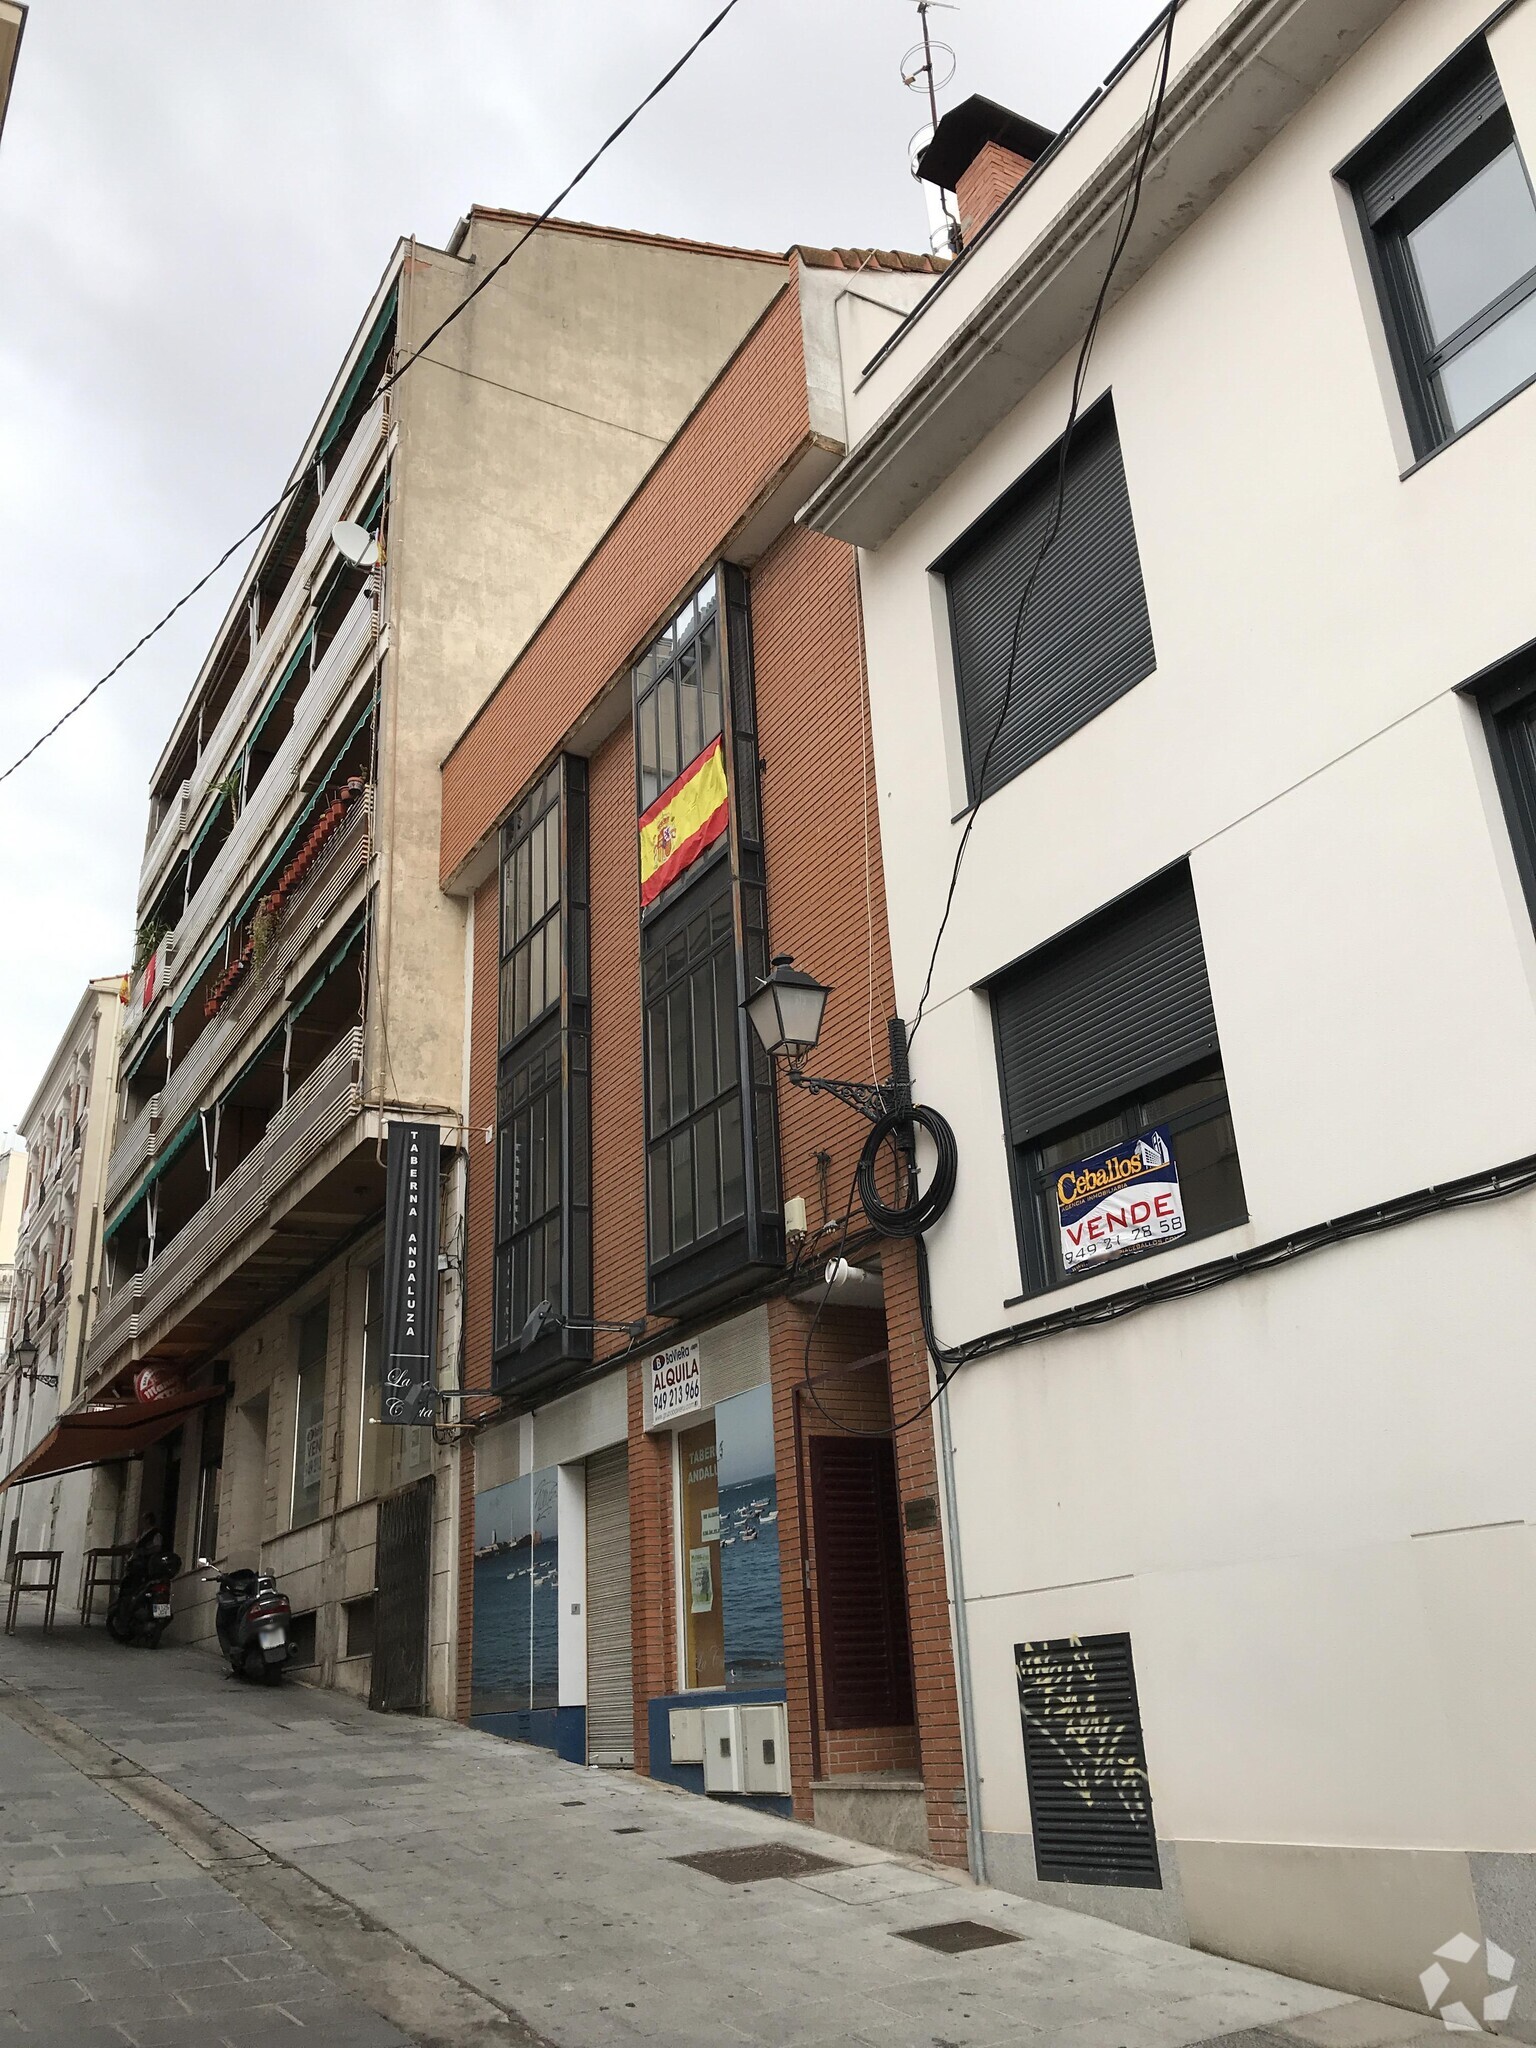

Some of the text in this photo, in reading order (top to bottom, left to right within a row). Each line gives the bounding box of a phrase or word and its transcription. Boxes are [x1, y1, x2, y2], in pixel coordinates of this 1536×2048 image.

[1057, 1153, 1142, 1205] Ceballos
[406, 1131, 419, 1337] TABERNA ANDALUZA
[1065, 1216, 1183, 1265] 949 21 78 58
[1066, 1193, 1175, 1246] VENDE
[384, 1367, 412, 1388] La
[653, 1358, 699, 1393] ALQUILA
[653, 1379, 699, 1413] 949 213 966
